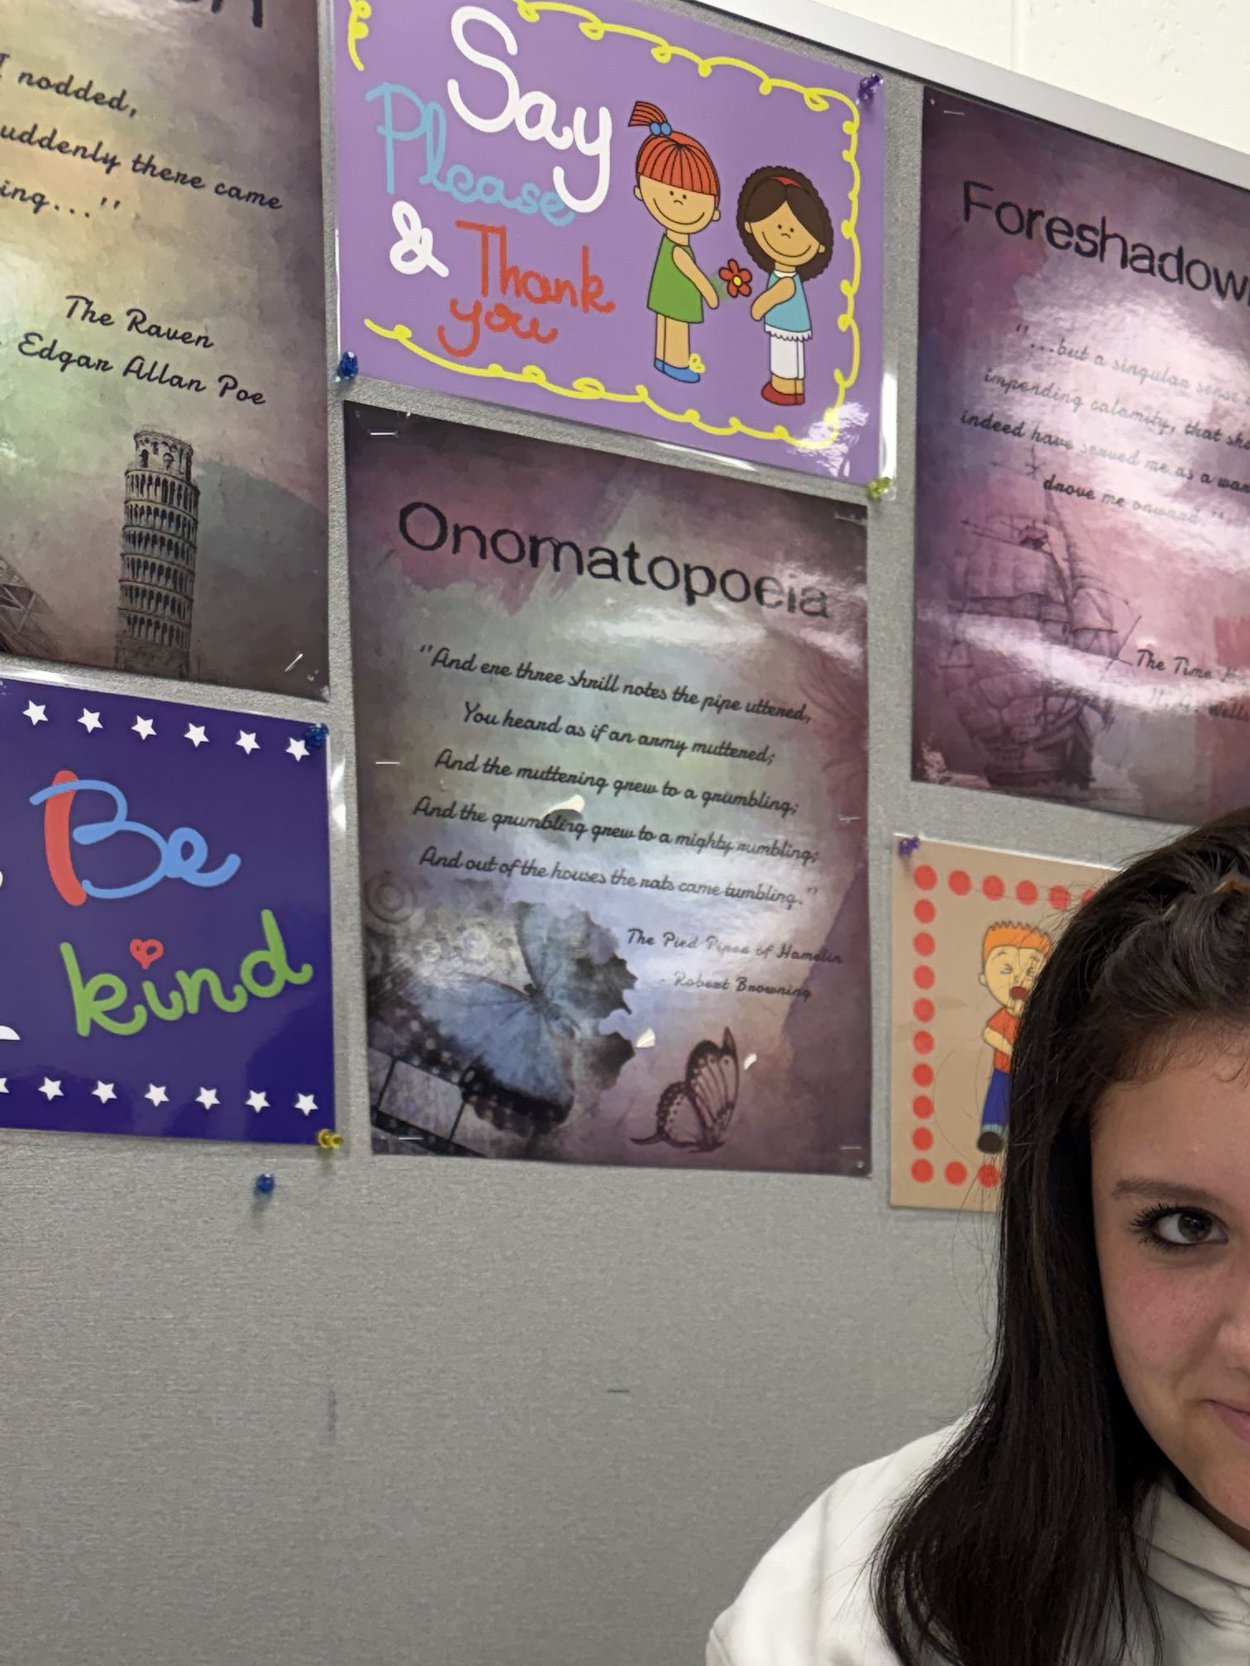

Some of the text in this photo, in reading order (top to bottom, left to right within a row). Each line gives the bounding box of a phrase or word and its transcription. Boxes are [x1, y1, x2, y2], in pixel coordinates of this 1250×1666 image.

[18, 75, 137, 118] nodded,
[447, 5, 612, 213] Say
[0, 124, 283, 210] uddenly there came
[365, 82, 576, 227] Please
[389, 200, 616, 314] & Thank
[65, 295, 215, 349] The Raven
[437, 298, 559, 358] you
[18, 332, 267, 405] Edgar Allan Poe
[984, 369, 1084, 412] impending
[1184, 421, 1222, 442] that
[960, 411, 1025, 438] indeed
[1031, 425, 1074, 450] have
[1175, 466, 1193, 480] as
[1200, 473, 1213, 485] a
[1043, 475, 1125, 508] drove me
[398, 501, 830, 619] Onomatopoeia
[480, 663, 512, 677] ere
[516, 662, 565, 685] three
[568, 669, 620, 693] shrill
[622, 682, 667, 700] notes
[672, 685, 700, 705] the
[701, 694, 742, 714] pipe
[745, 699, 812, 724] uttered,
[1136, 649, 1213, 679] The Time
[464, 701, 776, 766] You heard as if an army muttered;
[434, 748, 799, 818] And the muttering grew to a grumbling;
[29, 770, 241, 906] Be
[413, 795, 820, 866] And the grumbling grew to a mighty rumbling;
[419, 845, 463, 867] And
[465, 858, 499, 872] out
[499, 859, 521, 877] of
[521, 859, 549, 877] the
[551, 862, 607, 884] houses
[610, 869, 639, 887] the
[639, 875, 675, 891] rats
[679, 880, 721, 896] came
[60, 909, 314, 1037] kind
[627, 929, 655, 946] The
[776, 944, 843, 964] Hamelin
[736, 976, 812, 1002] Browning
